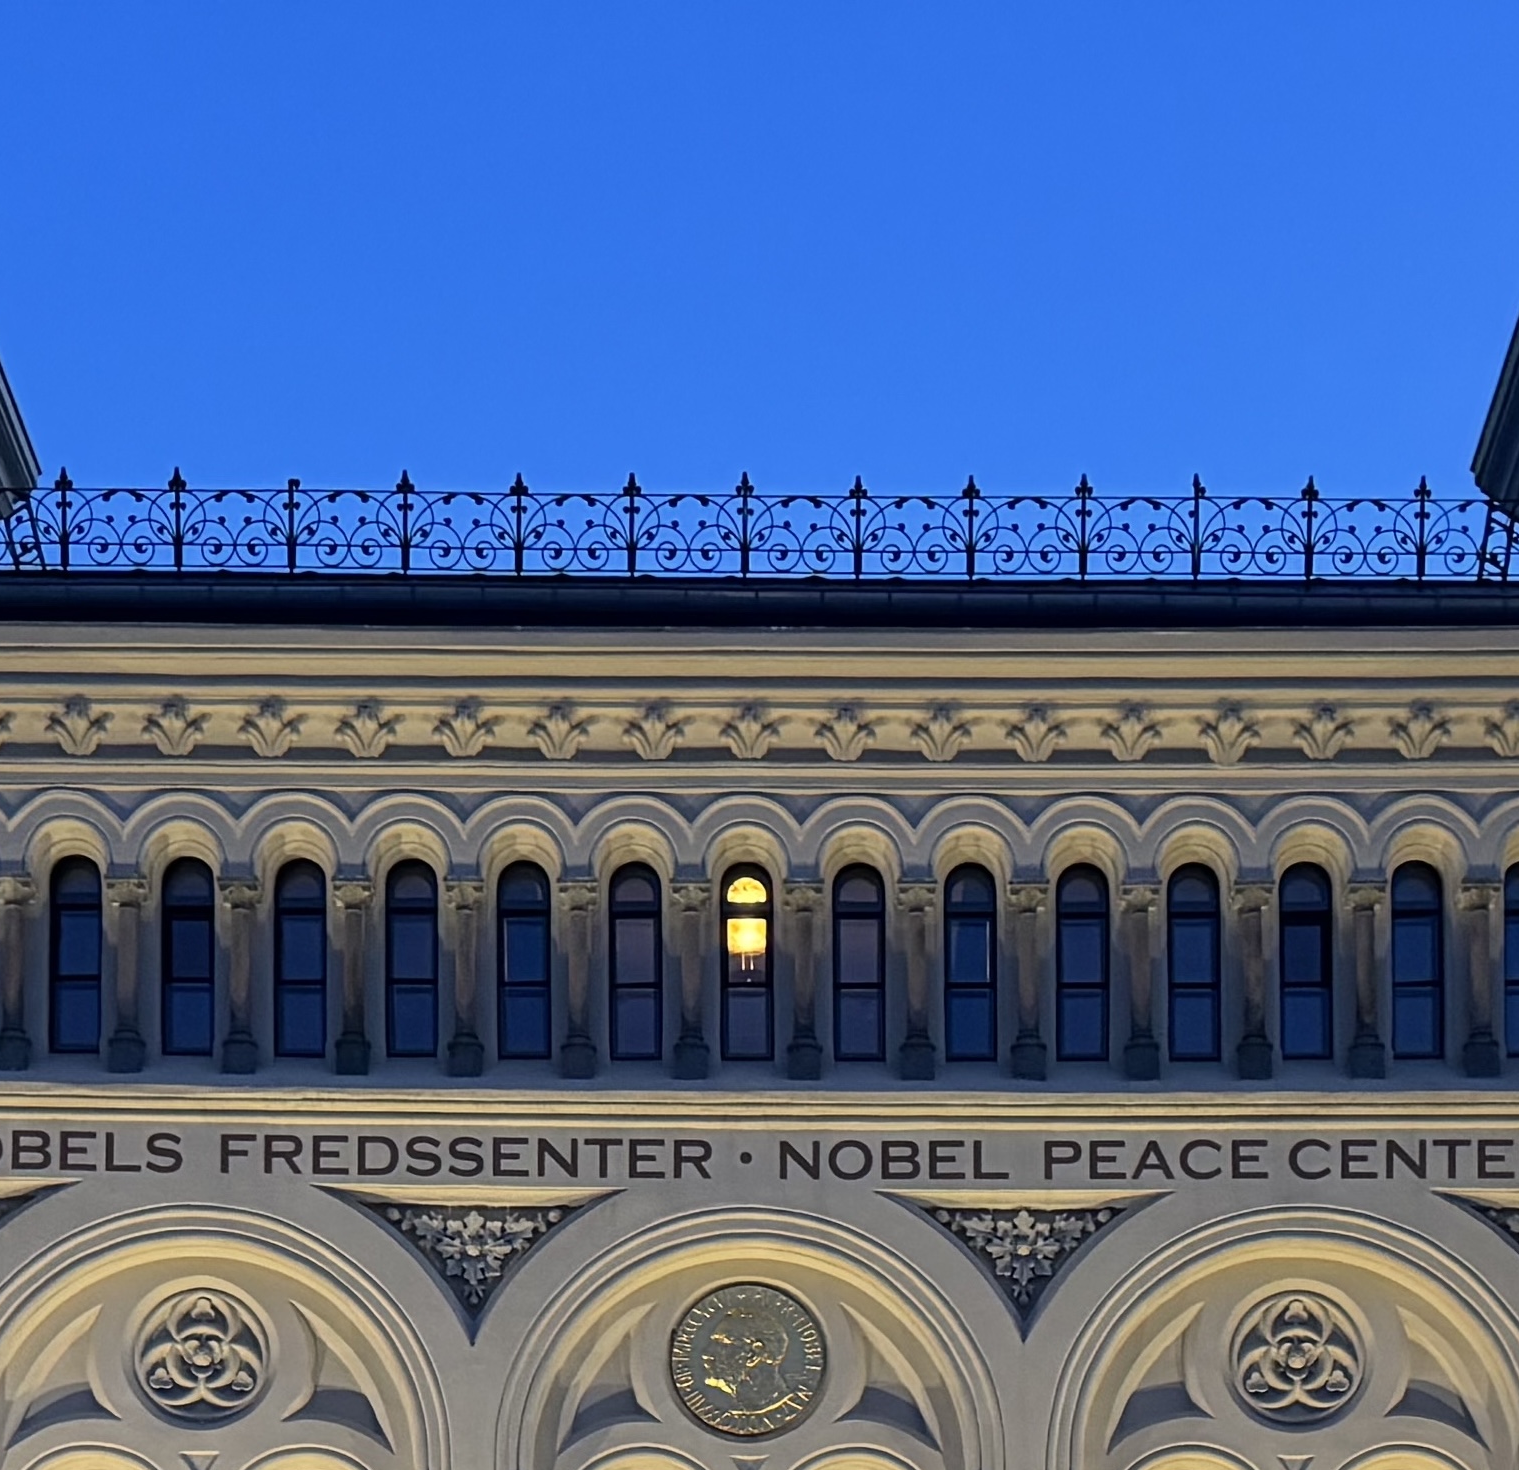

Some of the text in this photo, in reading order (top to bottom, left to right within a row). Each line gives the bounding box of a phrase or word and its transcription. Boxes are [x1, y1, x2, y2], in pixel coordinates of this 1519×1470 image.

[220, 1133, 713, 1180] FREDSSENTER
[779, 1139, 1010, 1181] NOBEL
[1043, 1139, 1269, 1181] PEACE
